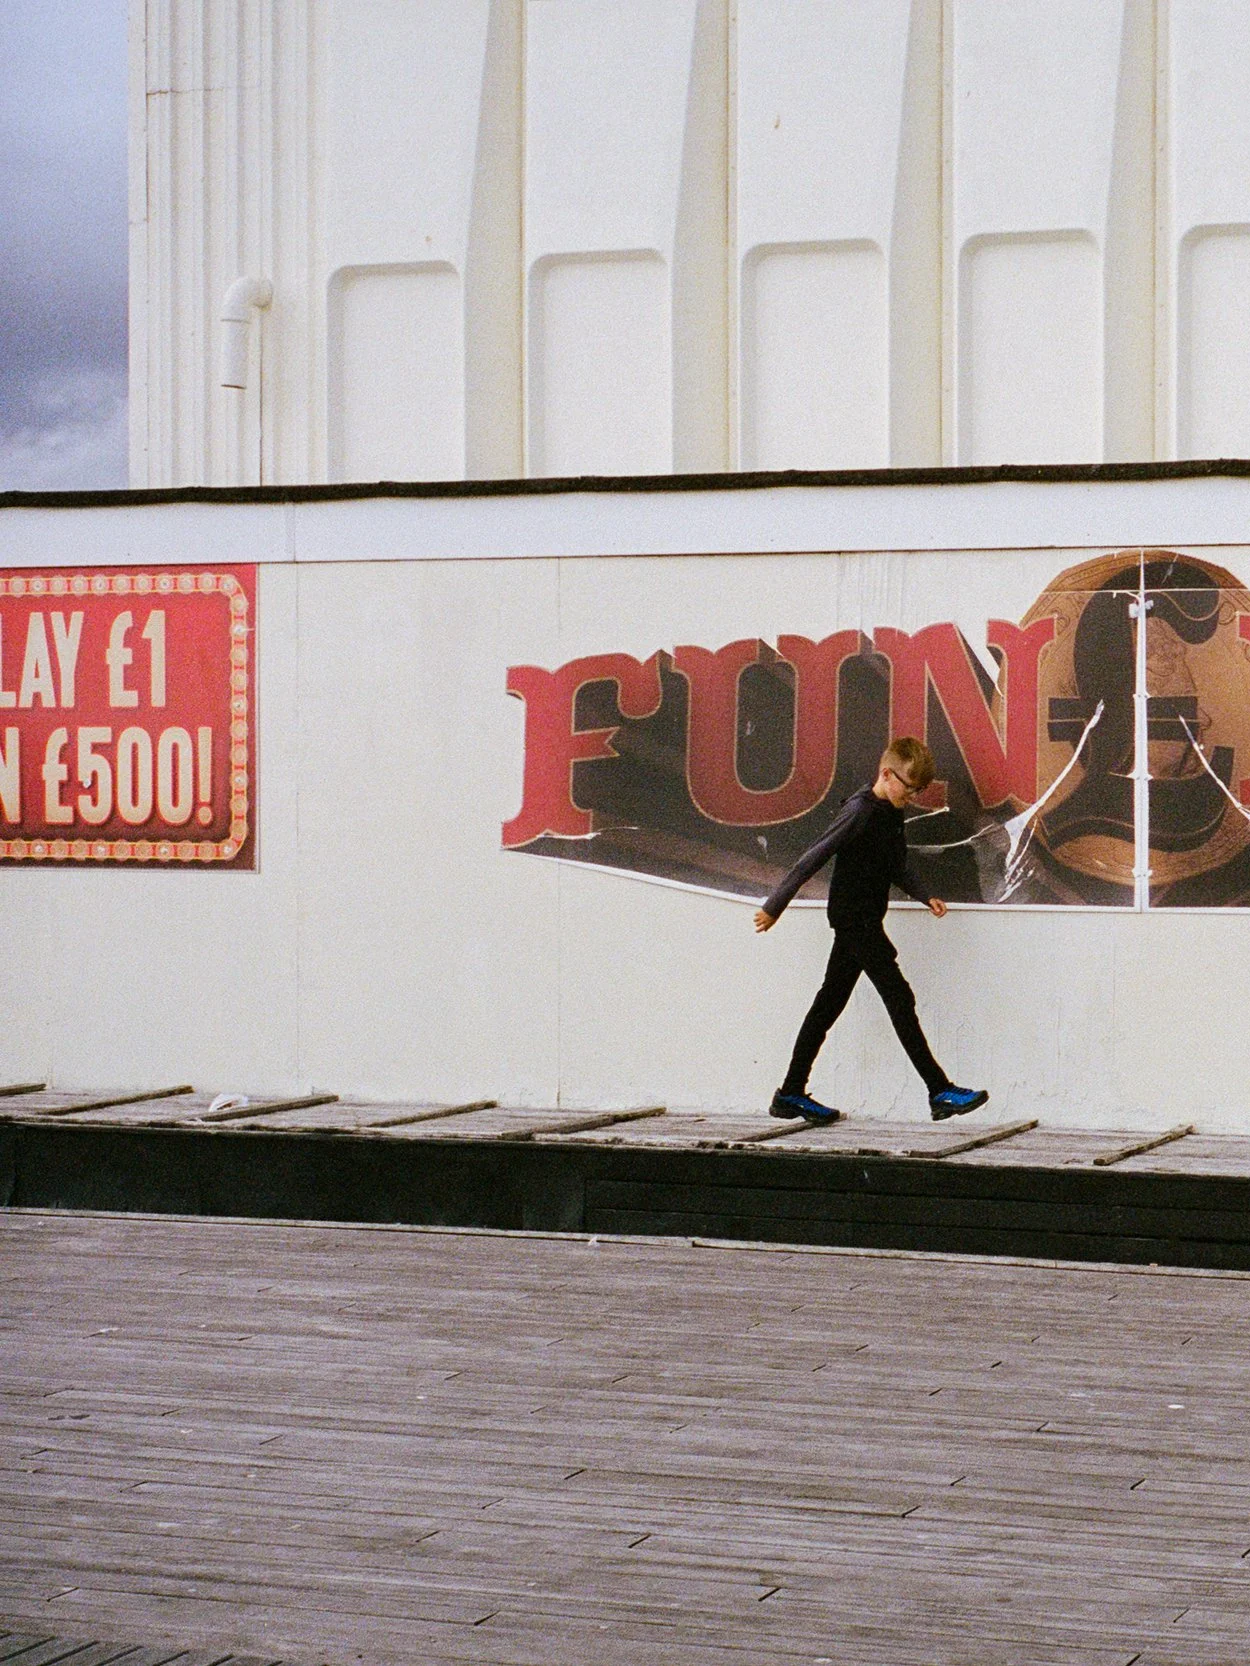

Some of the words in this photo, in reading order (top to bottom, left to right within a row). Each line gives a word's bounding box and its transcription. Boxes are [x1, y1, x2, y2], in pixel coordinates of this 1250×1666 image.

[106, 610, 166, 707] £1
[42, 726, 212, 824] £500!
[501, 615, 1056, 849] FUN
